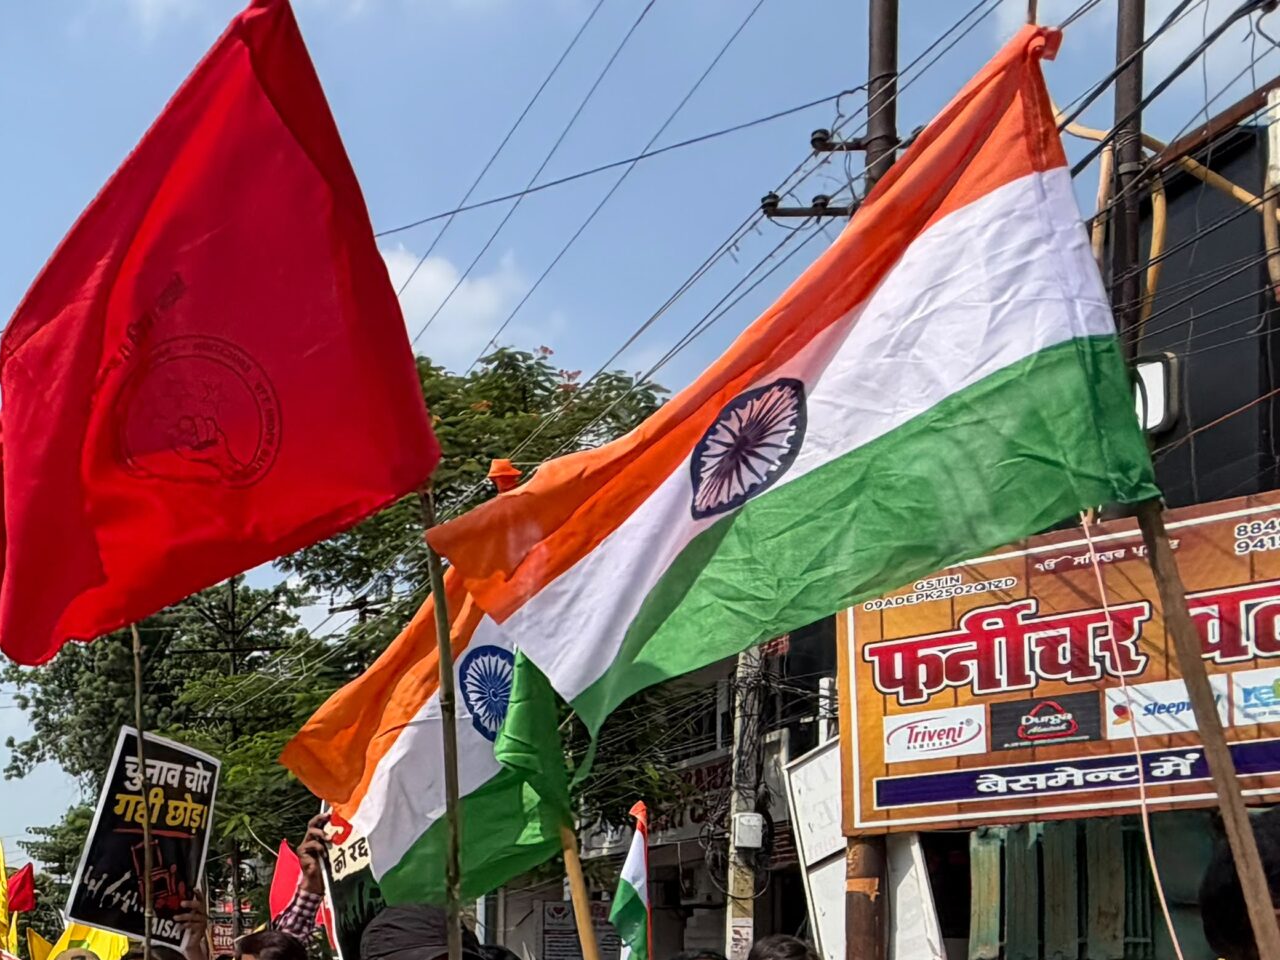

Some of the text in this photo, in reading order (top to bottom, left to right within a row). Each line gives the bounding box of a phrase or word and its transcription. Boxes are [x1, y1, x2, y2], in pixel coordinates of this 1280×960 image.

[1235, 519, 1280, 537] 884
[1235, 536, 1280, 554] 941
[914, 575, 961, 591] GSTIN
[864, 599, 1150, 705] फर्नीचर
[907, 721, 963, 744] Triveni
[124, 756, 212, 794] चुनाव चोर
[976, 753, 1200, 793] बेसमेन्ट में
[334, 847, 346, 873] को
